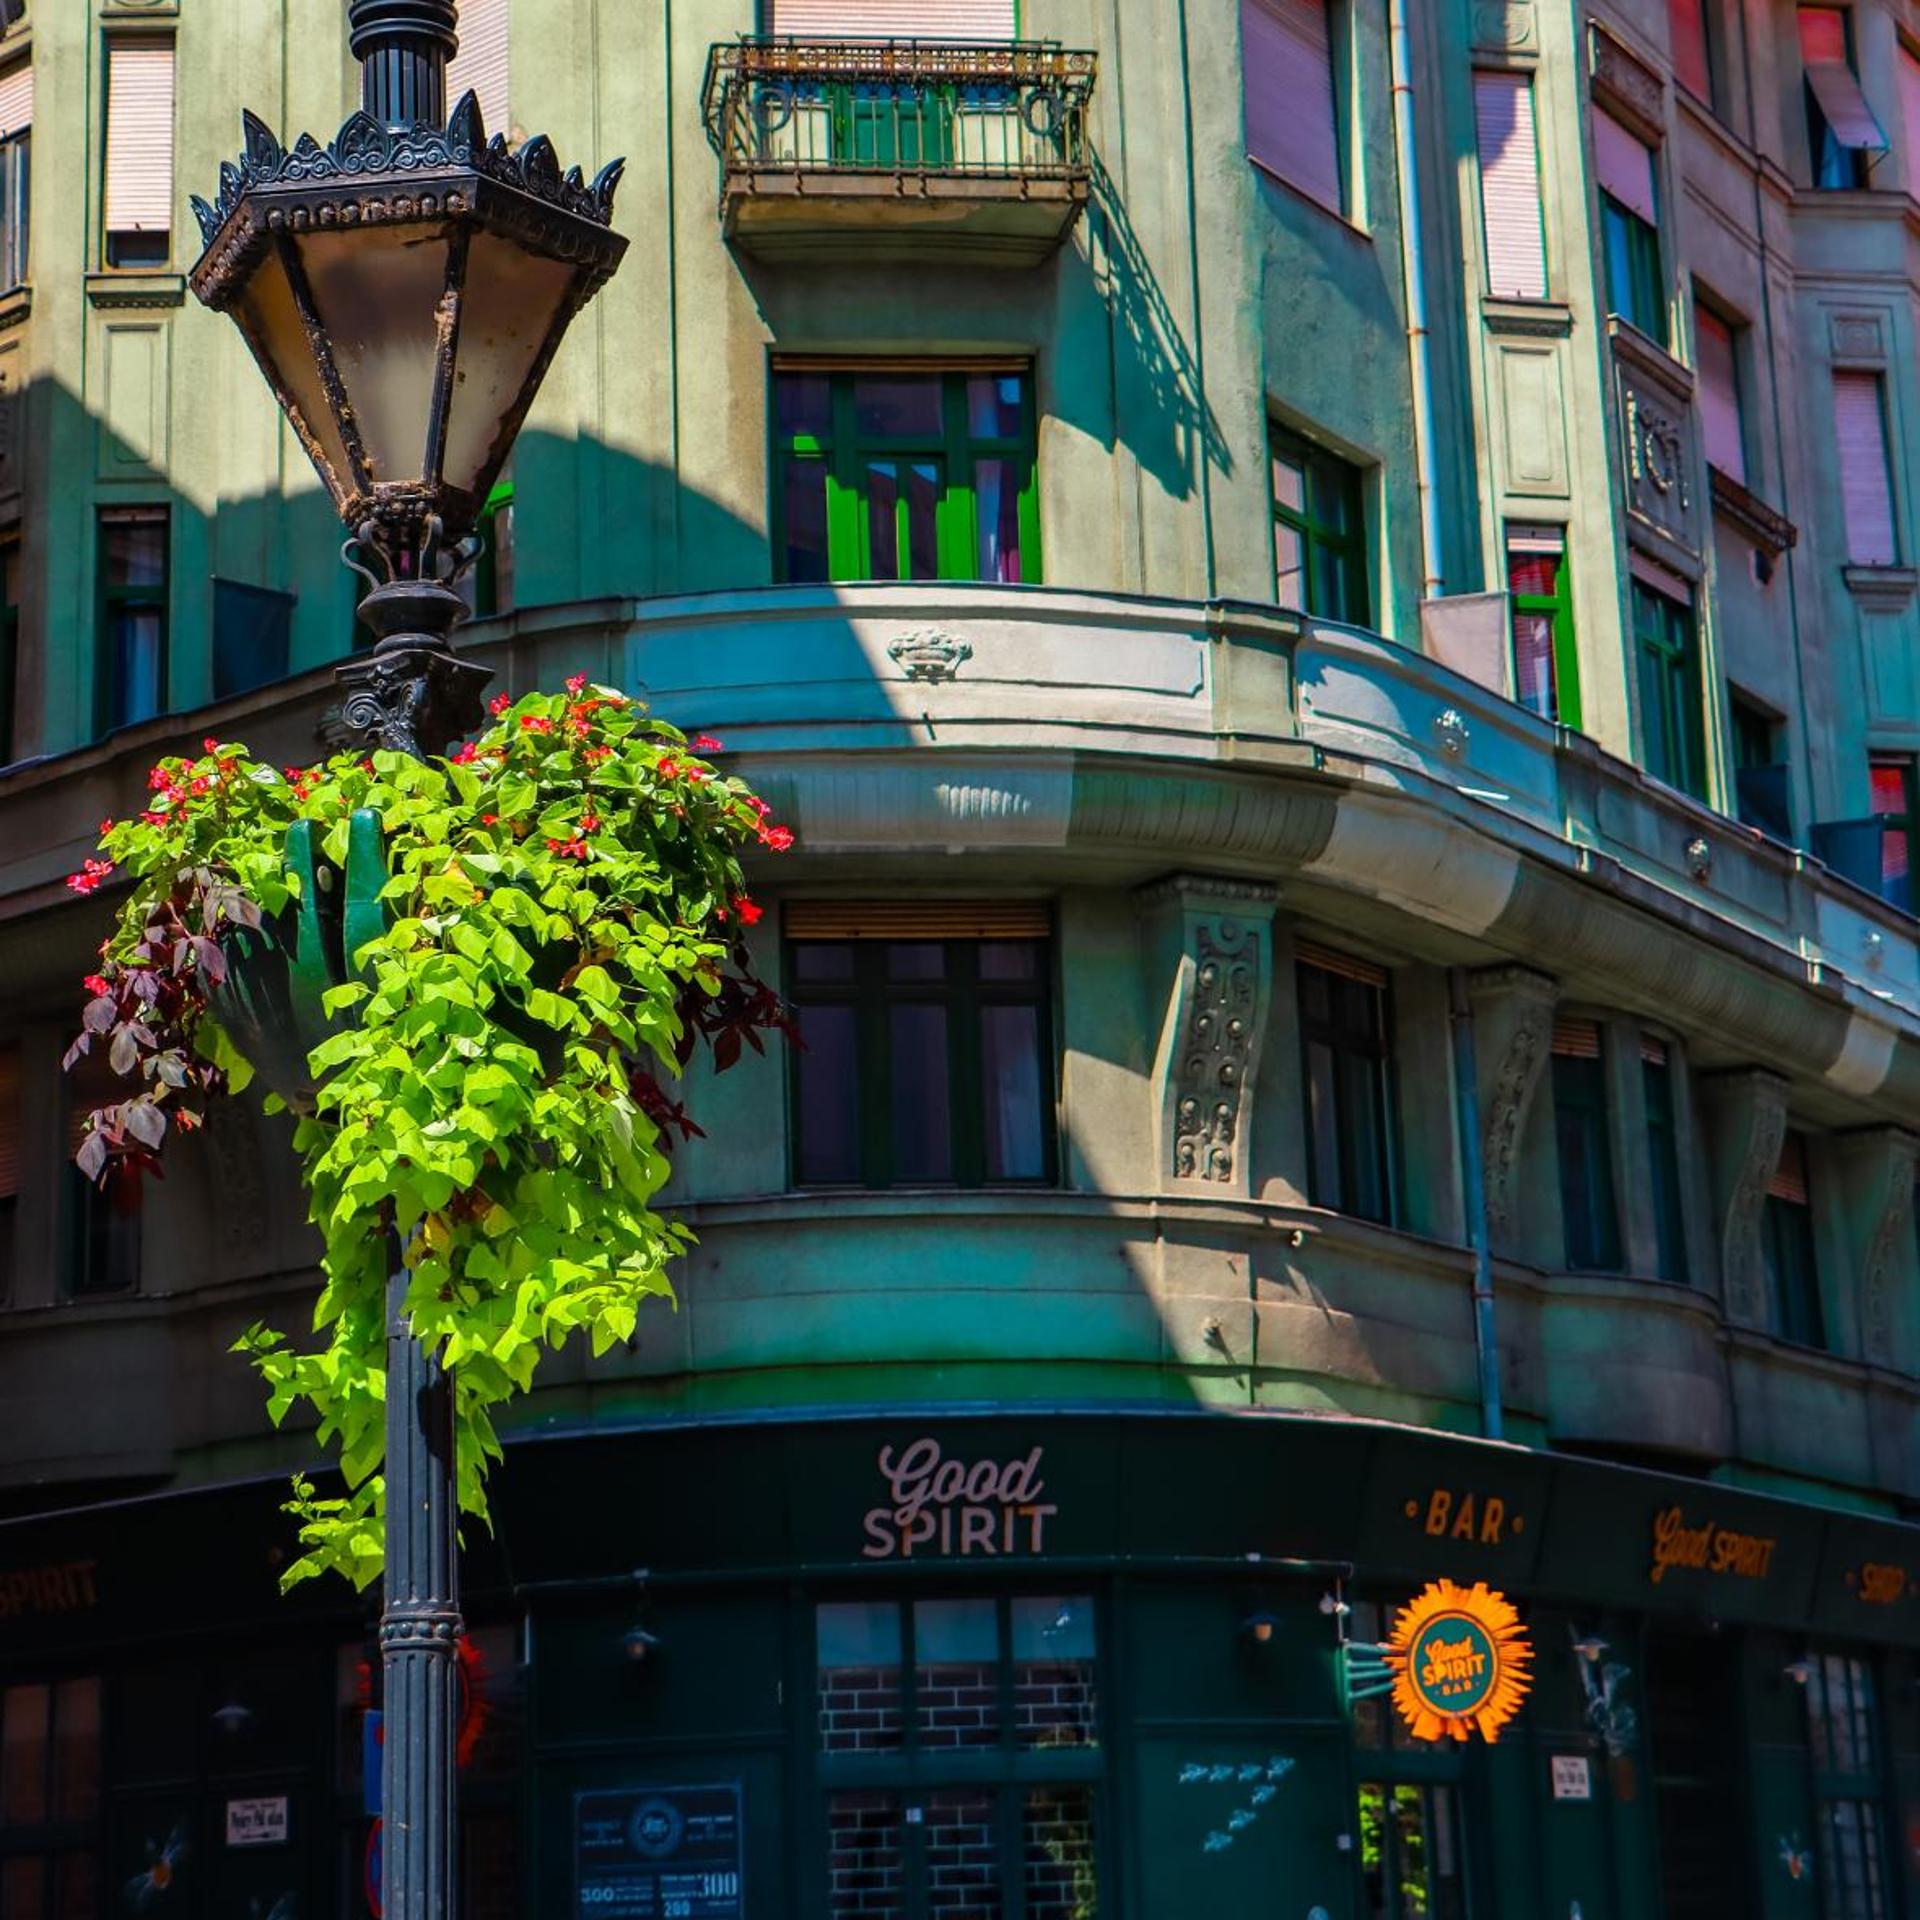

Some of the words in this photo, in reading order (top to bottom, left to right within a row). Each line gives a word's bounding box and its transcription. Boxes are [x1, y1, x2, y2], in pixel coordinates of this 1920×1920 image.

[878, 1437, 1045, 1526] Good
[862, 1503, 1059, 1558] SPIRIT
[1424, 1488, 1505, 1545] BAR
[1709, 1530, 1777, 1579] SPIRIT
[1422, 1653, 1485, 1686] SPIRIT
[1425, 1636, 1473, 1665] Good
